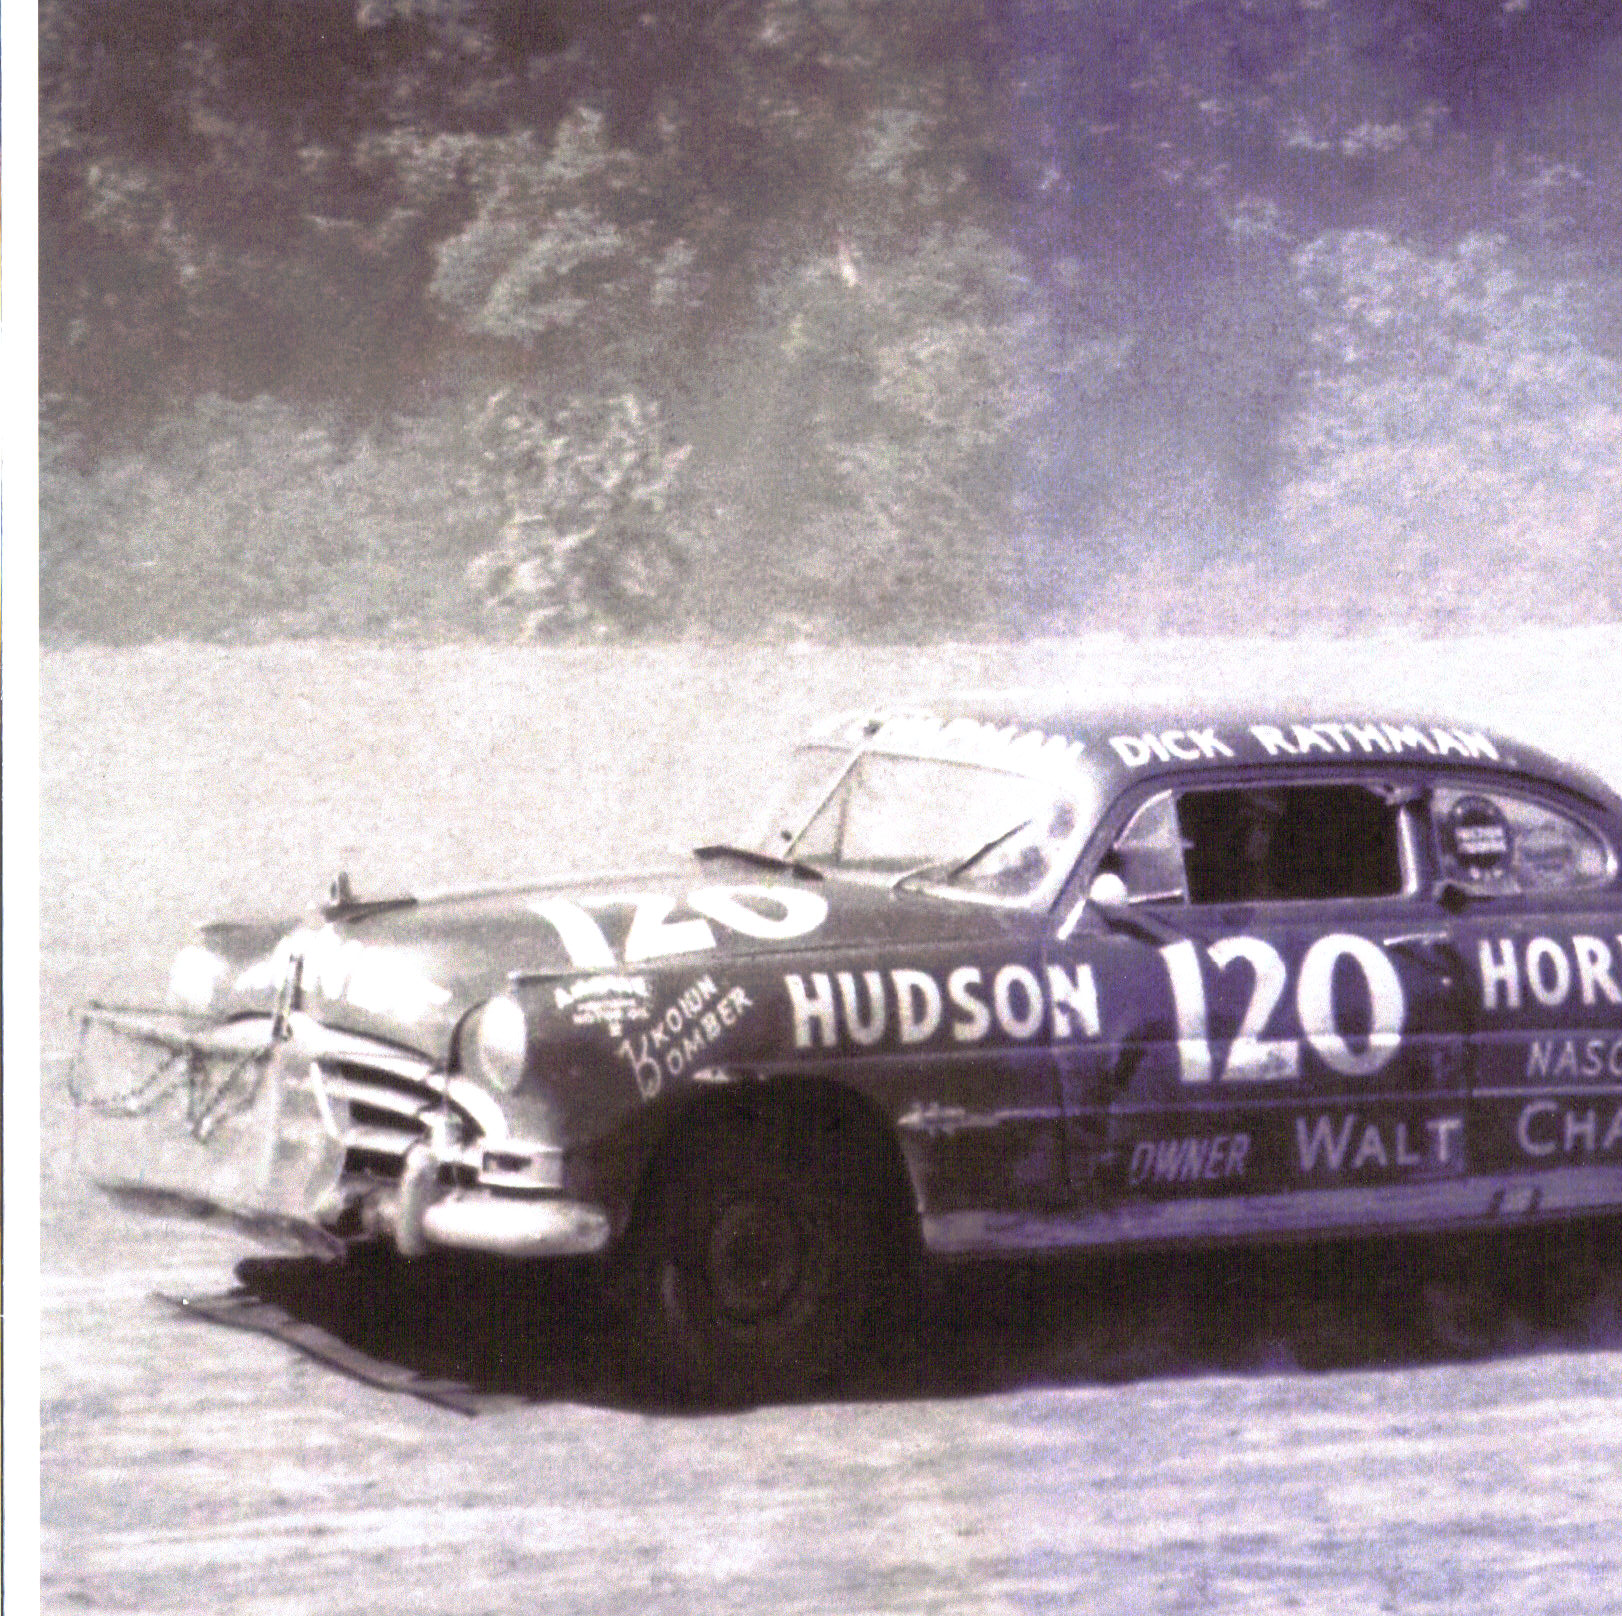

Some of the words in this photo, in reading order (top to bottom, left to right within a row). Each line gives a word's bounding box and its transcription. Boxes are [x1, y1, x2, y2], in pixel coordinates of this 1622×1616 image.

[1108, 727, 1236, 768] DICK
[527, 885, 829, 969] 120
[784, 963, 1101, 1047] HUDSON
[1160, 933, 1404, 1083] 120
[1128, 1133, 1251, 1186] OWNER
[1296, 1111, 1463, 1172] WALT
